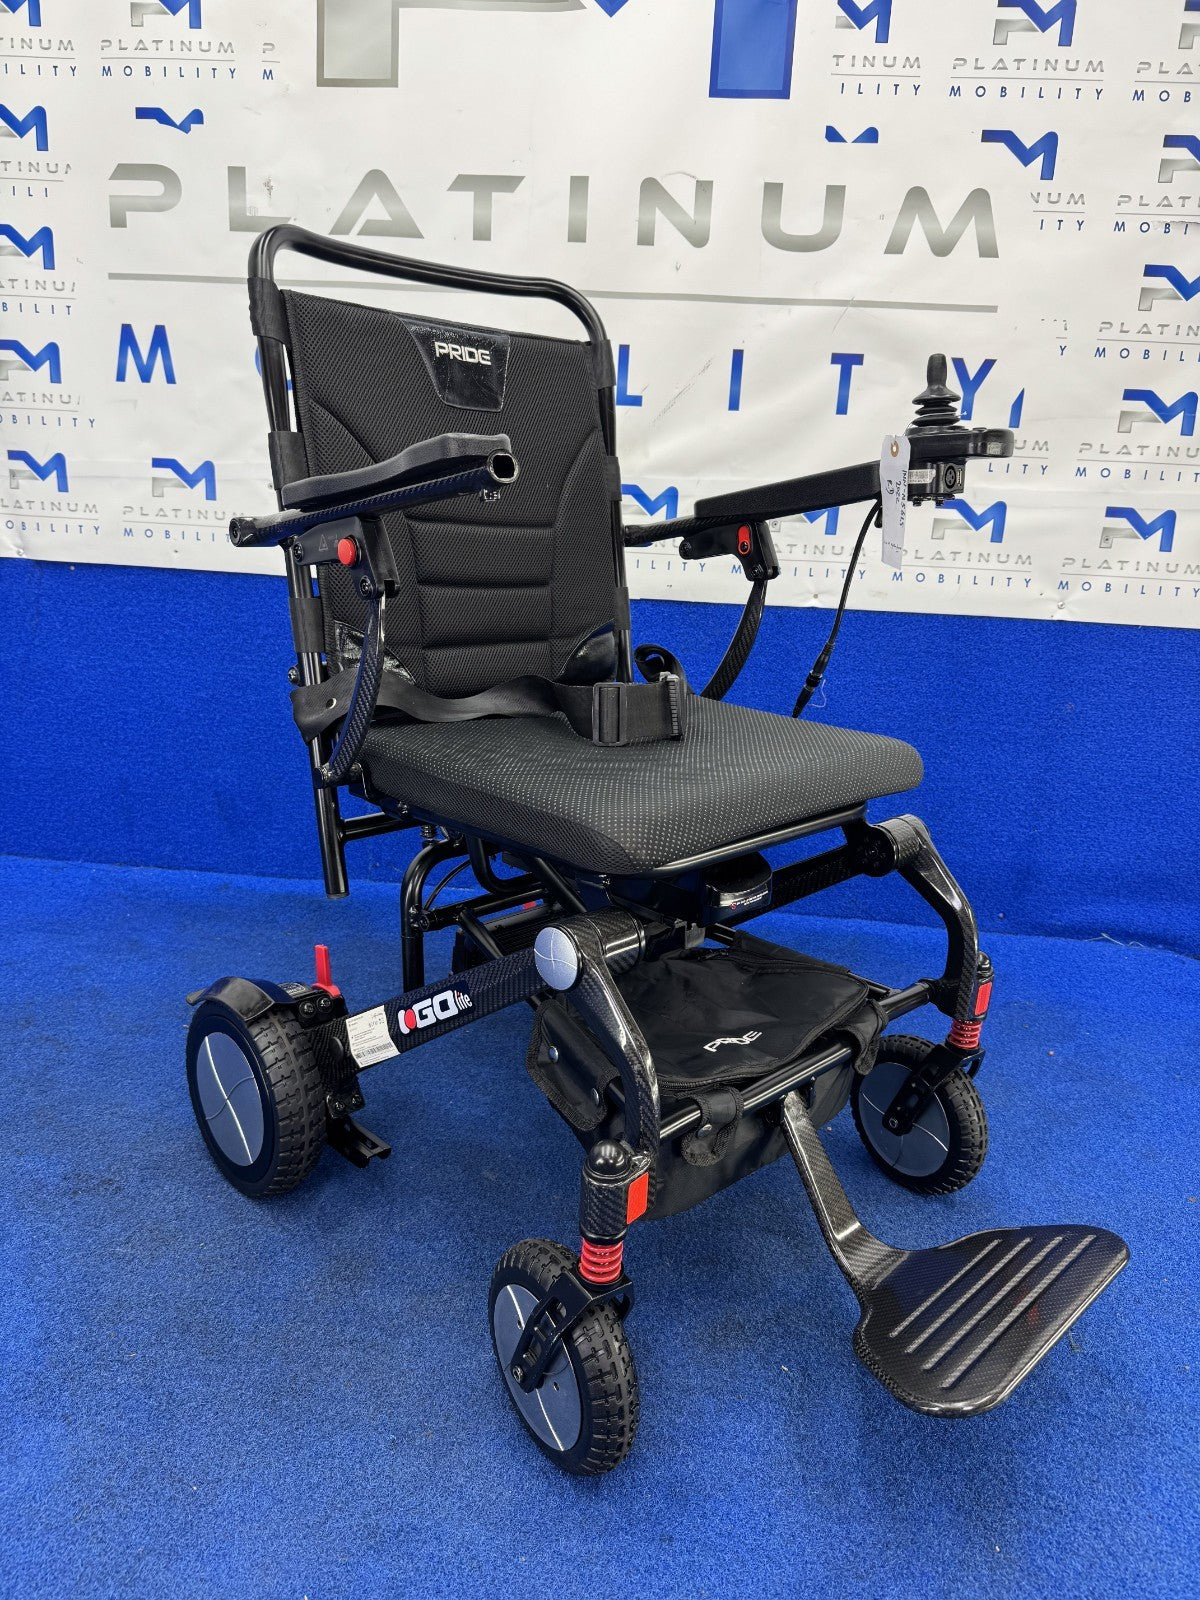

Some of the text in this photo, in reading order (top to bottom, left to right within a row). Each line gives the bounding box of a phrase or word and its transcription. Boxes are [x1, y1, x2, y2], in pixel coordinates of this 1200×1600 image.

[100, 38, 235, 54] PLATINUM
[101, 65, 236, 79] MOBILITY
[952, 57, 1104, 73] PLATINUM
[949, 86, 1104, 101] MOBILITY
[109, 163, 999, 258] PLATINUM
[434, 341, 492, 366] PRIDE
[1062, 556, 1200, 576] PLATINUM
[892, 571, 1032, 589] MOBILITY
[1058, 580, 1200, 599] MOBILITY
